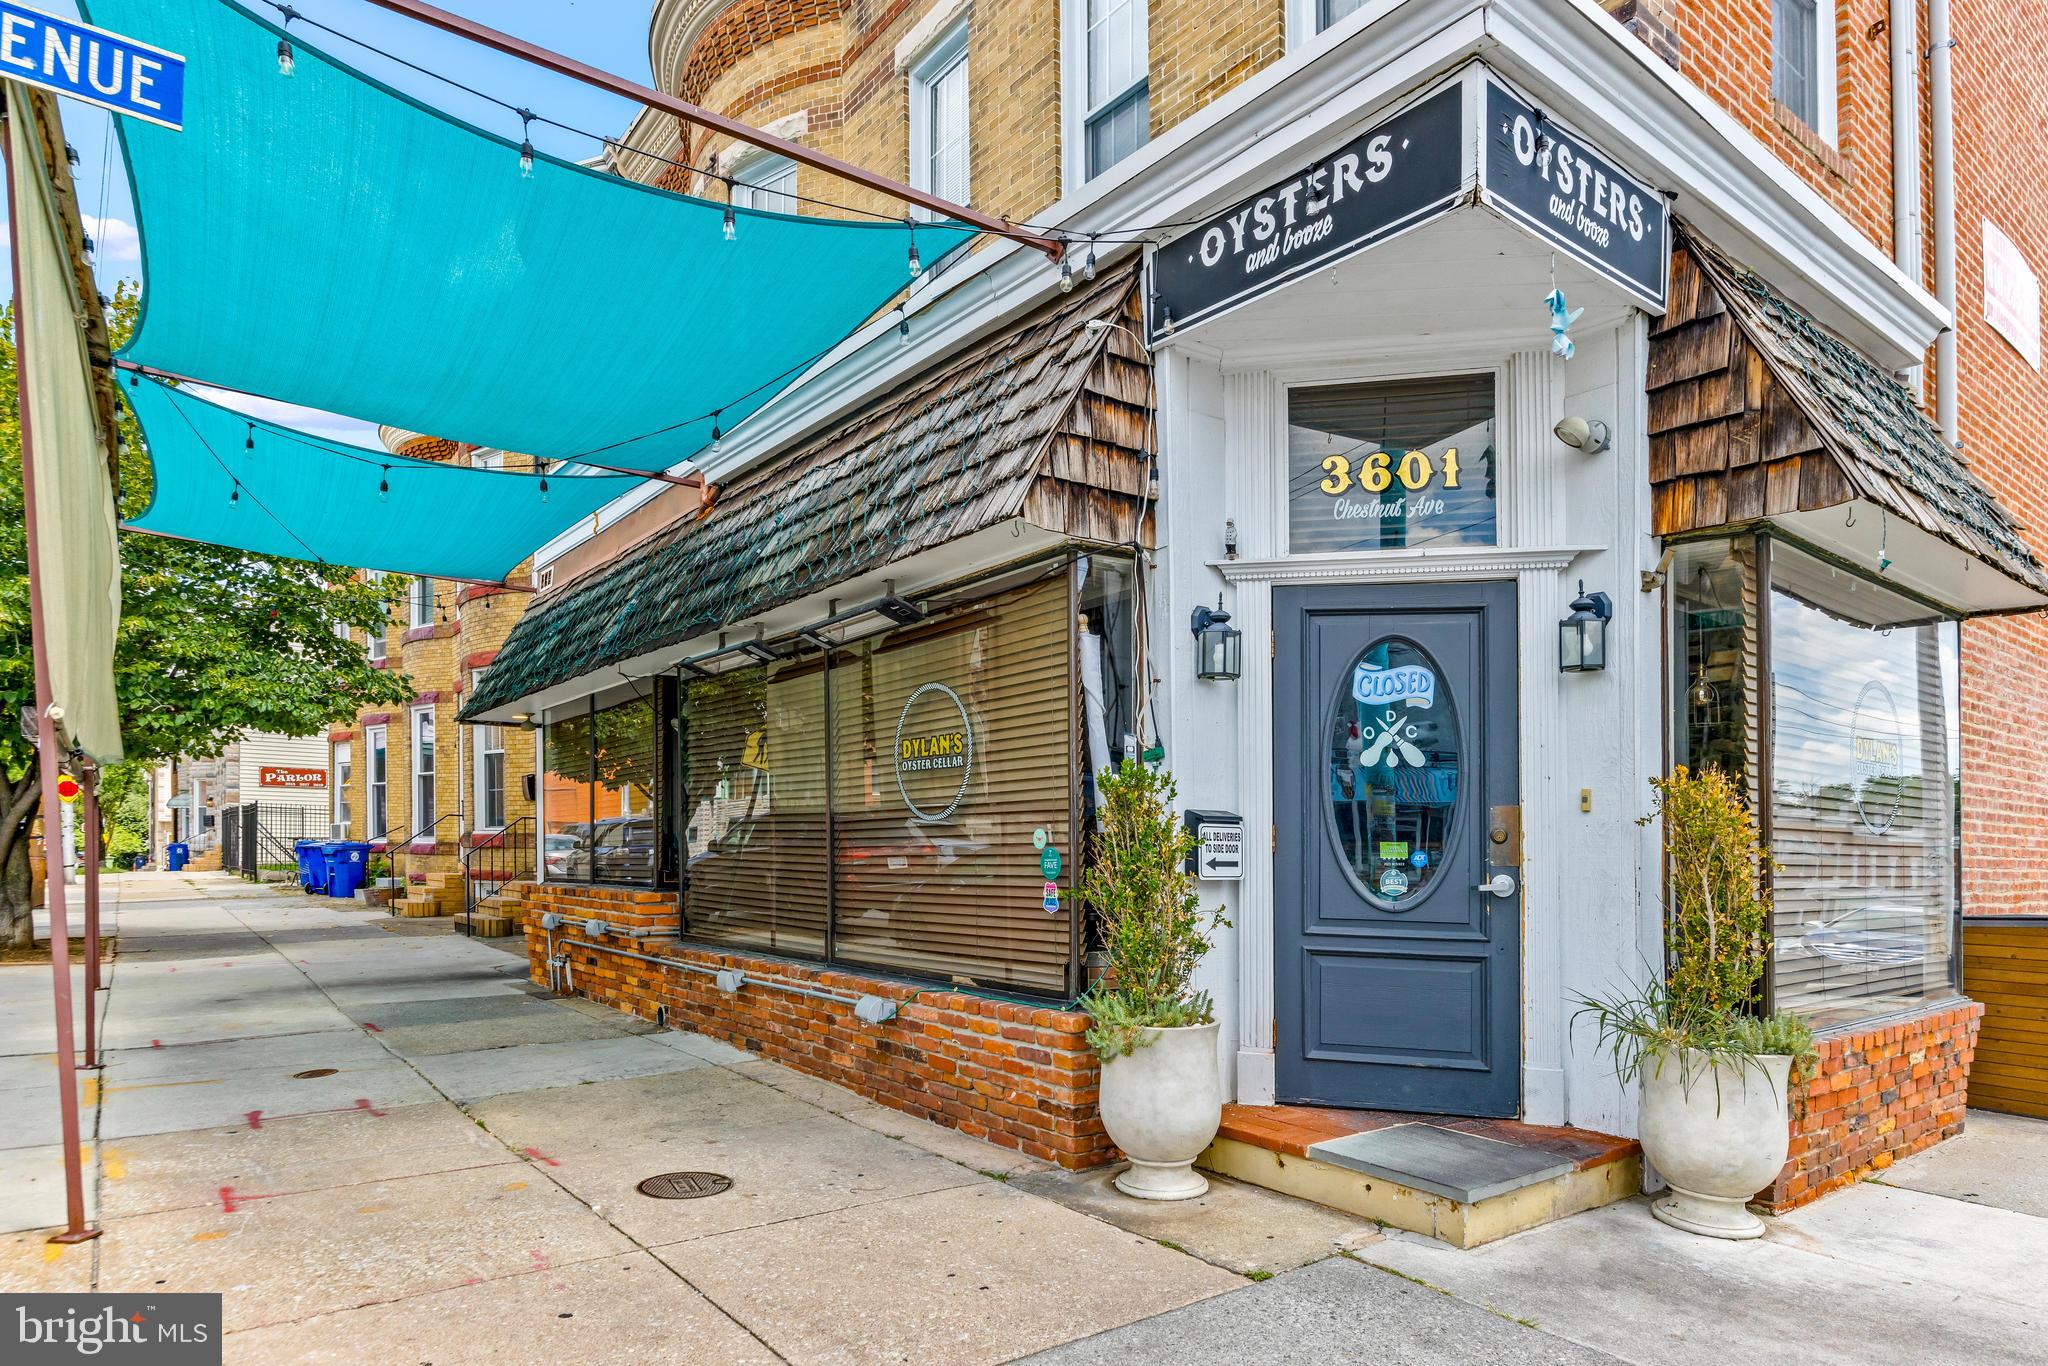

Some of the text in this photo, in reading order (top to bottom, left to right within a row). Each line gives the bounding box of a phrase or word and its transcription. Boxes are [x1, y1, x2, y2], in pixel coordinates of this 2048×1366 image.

[1199, 135, 1393, 267] OYSTERS
[1550, 194, 1610, 248] and booze
[1245, 214, 1334, 274] and booze
[1320, 448, 1462, 497] 3601
[1333, 495, 1445, 520] Chestnut Ave
[1358, 670, 1431, 698] CLOSED
[1386, 710, 1397, 722] D
[902, 732, 963, 759] DYLAN'S
[1363, 725, 1418, 740] O C
[902, 756, 964, 771] OYSTER CELLAR
[1856, 736, 1898, 767] DYLAN'S
[1203, 831, 1241, 842] ALL DELIVERIES
[1205, 844, 1239, 854] TO SIDE DOOR
[1043, 861, 1058, 869] FAVE
